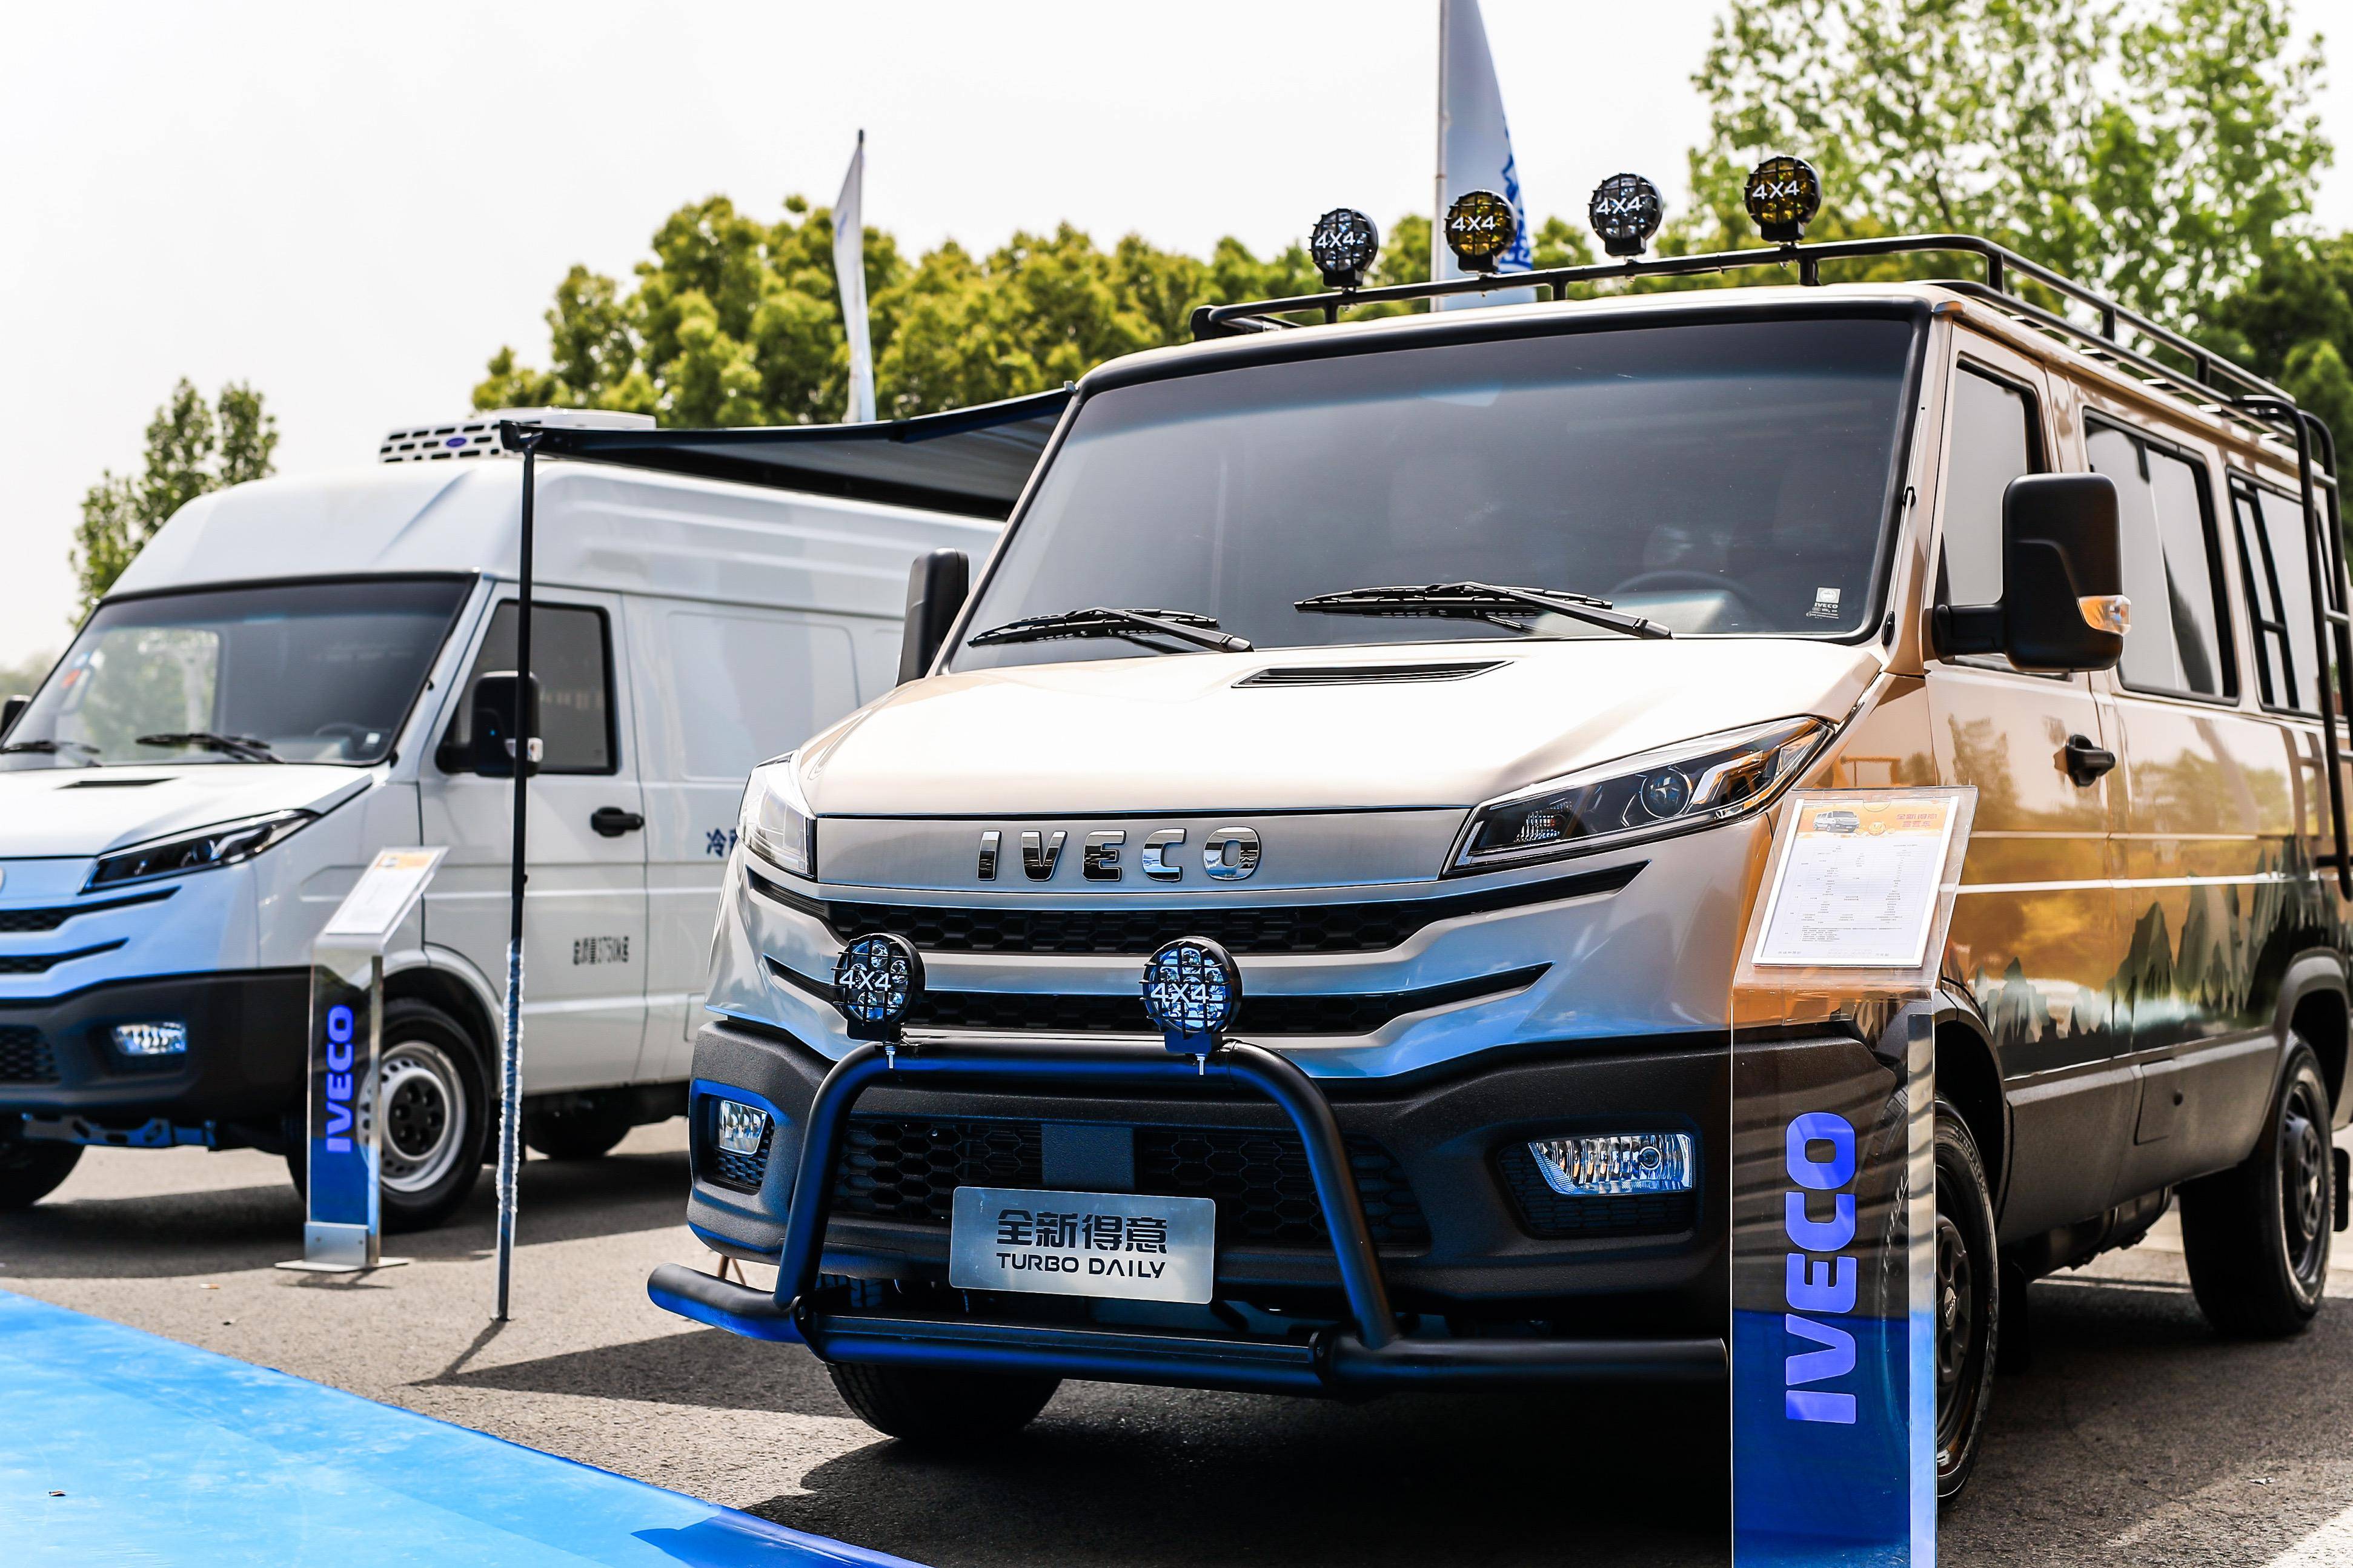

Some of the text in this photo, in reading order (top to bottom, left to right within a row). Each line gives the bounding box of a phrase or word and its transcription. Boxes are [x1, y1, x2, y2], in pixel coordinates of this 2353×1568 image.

[1751, 180, 1800, 200] 4X4
[1596, 196, 1643, 216] 4X4
[1452, 215, 1495, 231] 4X4
[1315, 231, 1356, 249] 4X4
[977, 826, 1262, 881] IVECO
[838, 968, 892, 991] 4X4
[1150, 982, 1210, 1004] 4X4
[326, 1005, 354, 1153] IVECO
[997, 1209, 1167, 1254] 全新得意
[996, 1253, 1166, 1279] TURBO DAILY
[1786, 1112, 1856, 1424] IVECO
